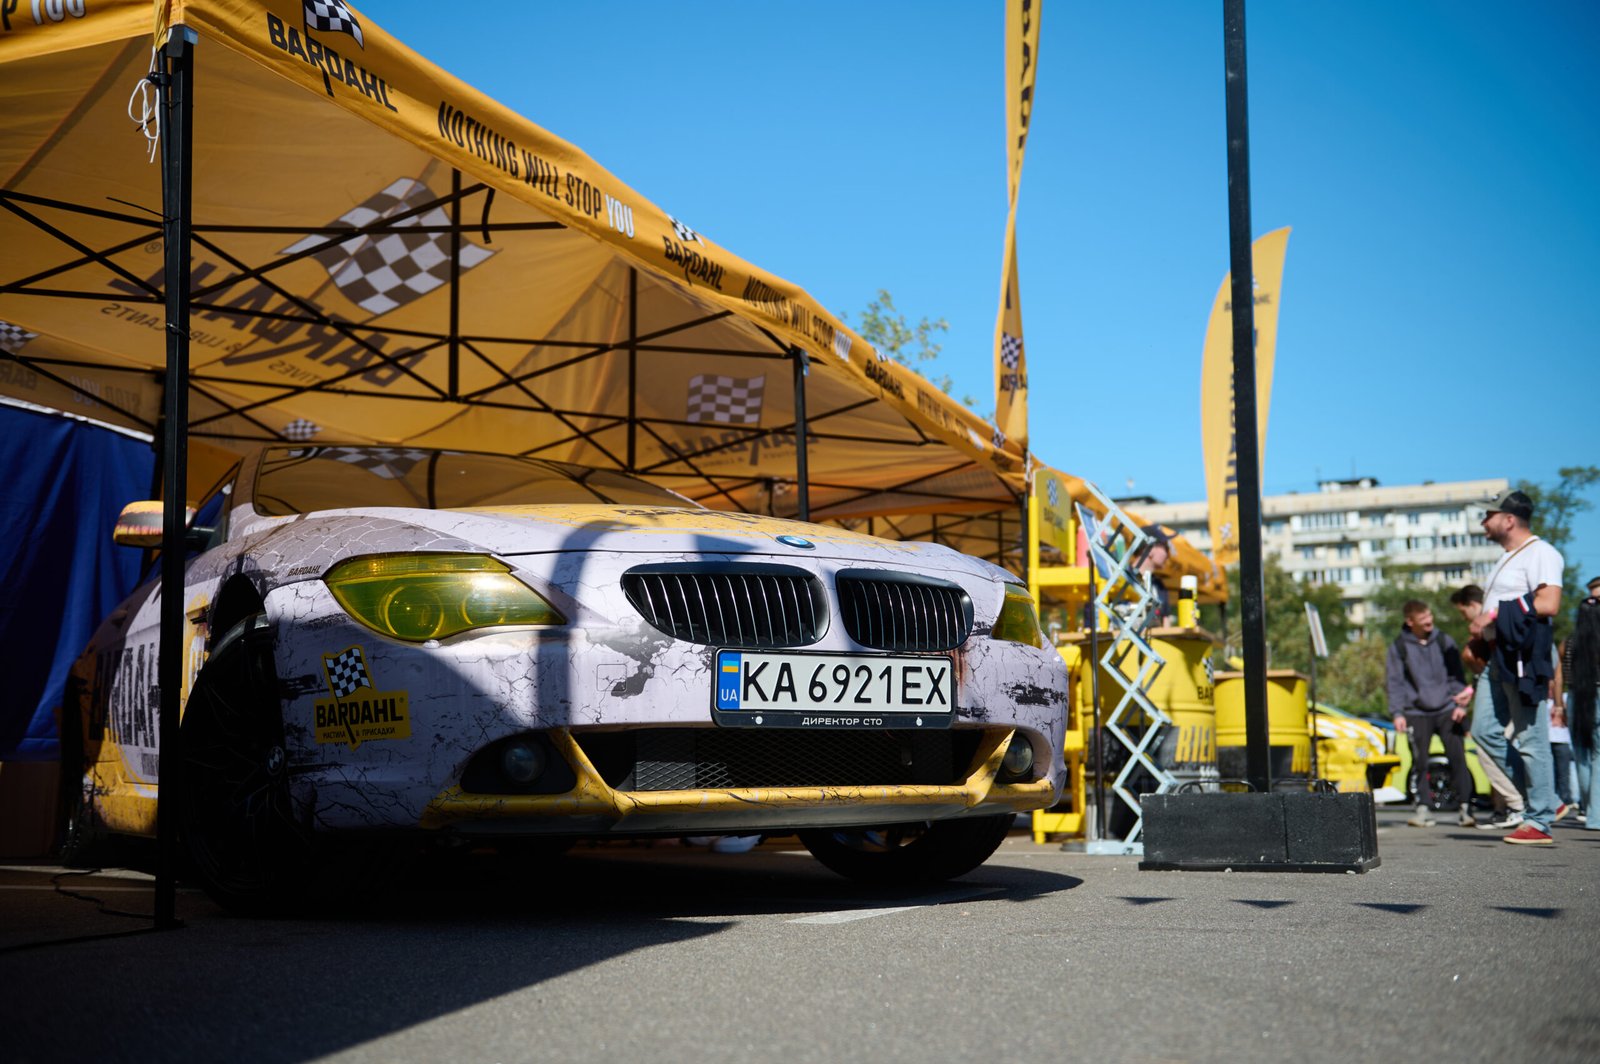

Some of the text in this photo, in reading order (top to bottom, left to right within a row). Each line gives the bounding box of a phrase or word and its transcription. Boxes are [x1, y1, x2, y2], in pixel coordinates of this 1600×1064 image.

[267, 12, 398, 113] BARDAHL
[437, 100, 636, 239] NOTHING WILL STOP YOU
[662, 234, 723, 291] BARDAHL
[287, 564, 321, 577] BARDAHL
[721, 688, 738, 702] UA
[743, 661, 947, 705] KA 6921 EX
[316, 698, 404, 729] BARDAHL
[802, 717, 883, 726] ДИРЕКТОР СТО
[362, 727, 396, 737] ПРИСАДКИ
